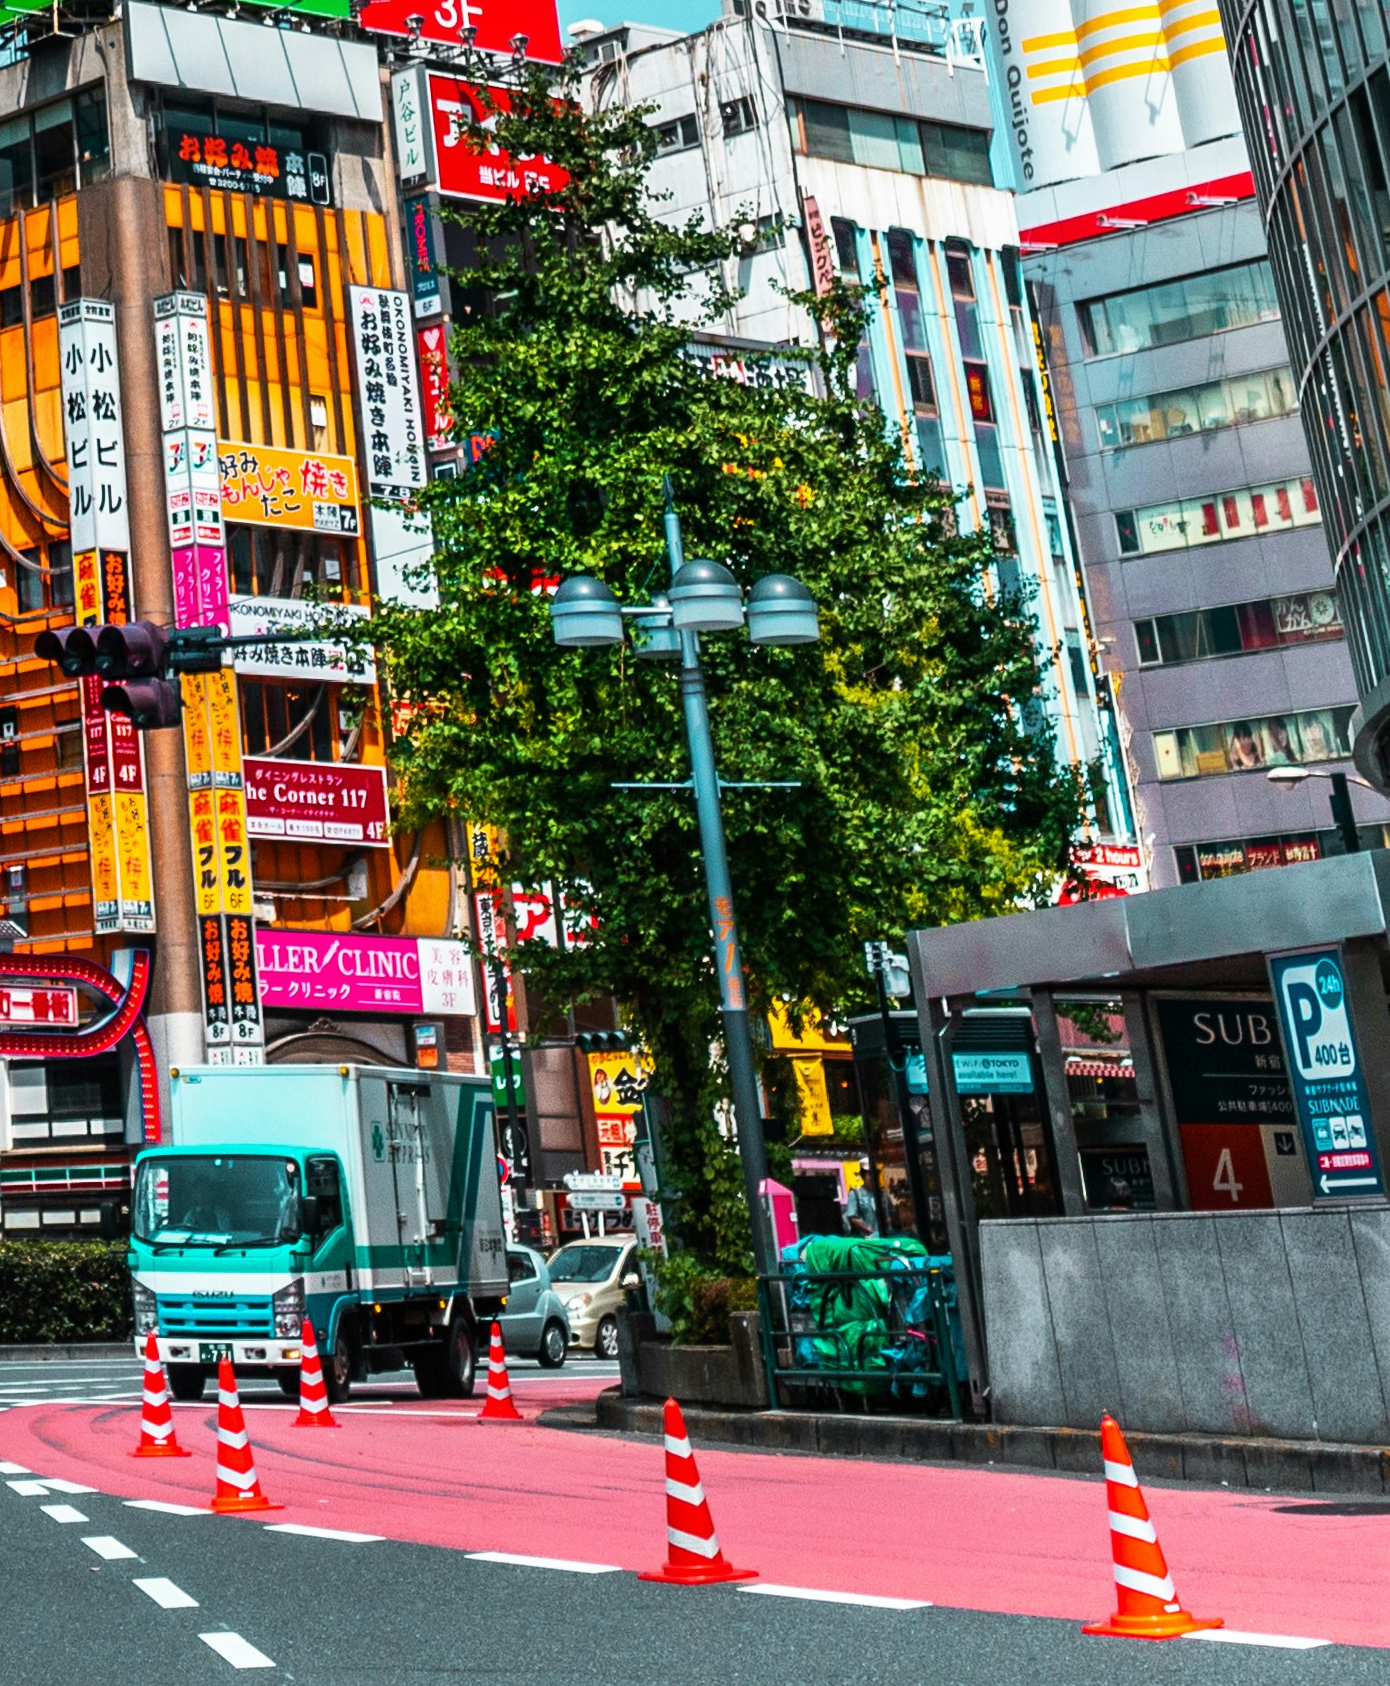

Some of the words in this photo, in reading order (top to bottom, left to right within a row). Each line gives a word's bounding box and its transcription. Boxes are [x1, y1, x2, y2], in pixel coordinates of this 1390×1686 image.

[399, 79, 419, 168] 戸谷ビル
[1006, 63, 1037, 182] Quijote
[179, 133, 280, 177] お好み焼
[393, 295, 414, 413] OKONOMIYAKI
[361, 311, 393, 479] お好み焼き本陣
[65, 342, 94, 517] 小松ビル
[89, 342, 123, 515] 小松ビル
[221, 466, 292, 505] もんじゃ
[300, 459, 350, 499] 焼き
[260, 488, 302, 518] たこ
[115, 725, 132, 737] 117
[118, 764, 137, 782] 4F
[255, 769, 343, 787] ダイニングレストラン
[273, 782, 335, 807] Corner
[341, 788, 368, 809] 117
[1095, 848, 1104, 862] 2
[1105, 848, 1139, 866] hours
[230, 892, 244, 910] 6F
[204, 919, 224, 1005] お好み焼
[230, 921, 254, 1004] お好み焼
[337, 948, 419, 980] CLINIC
[441, 992, 457, 1008] 3F
[1318, 975, 1341, 996] 24h
[238, 1022, 255, 1039] 8F
[1286, 981, 1323, 1071] P
[1307, 1096, 1361, 1115] SUBNADE
[1212, 1147, 1244, 1203] 4
